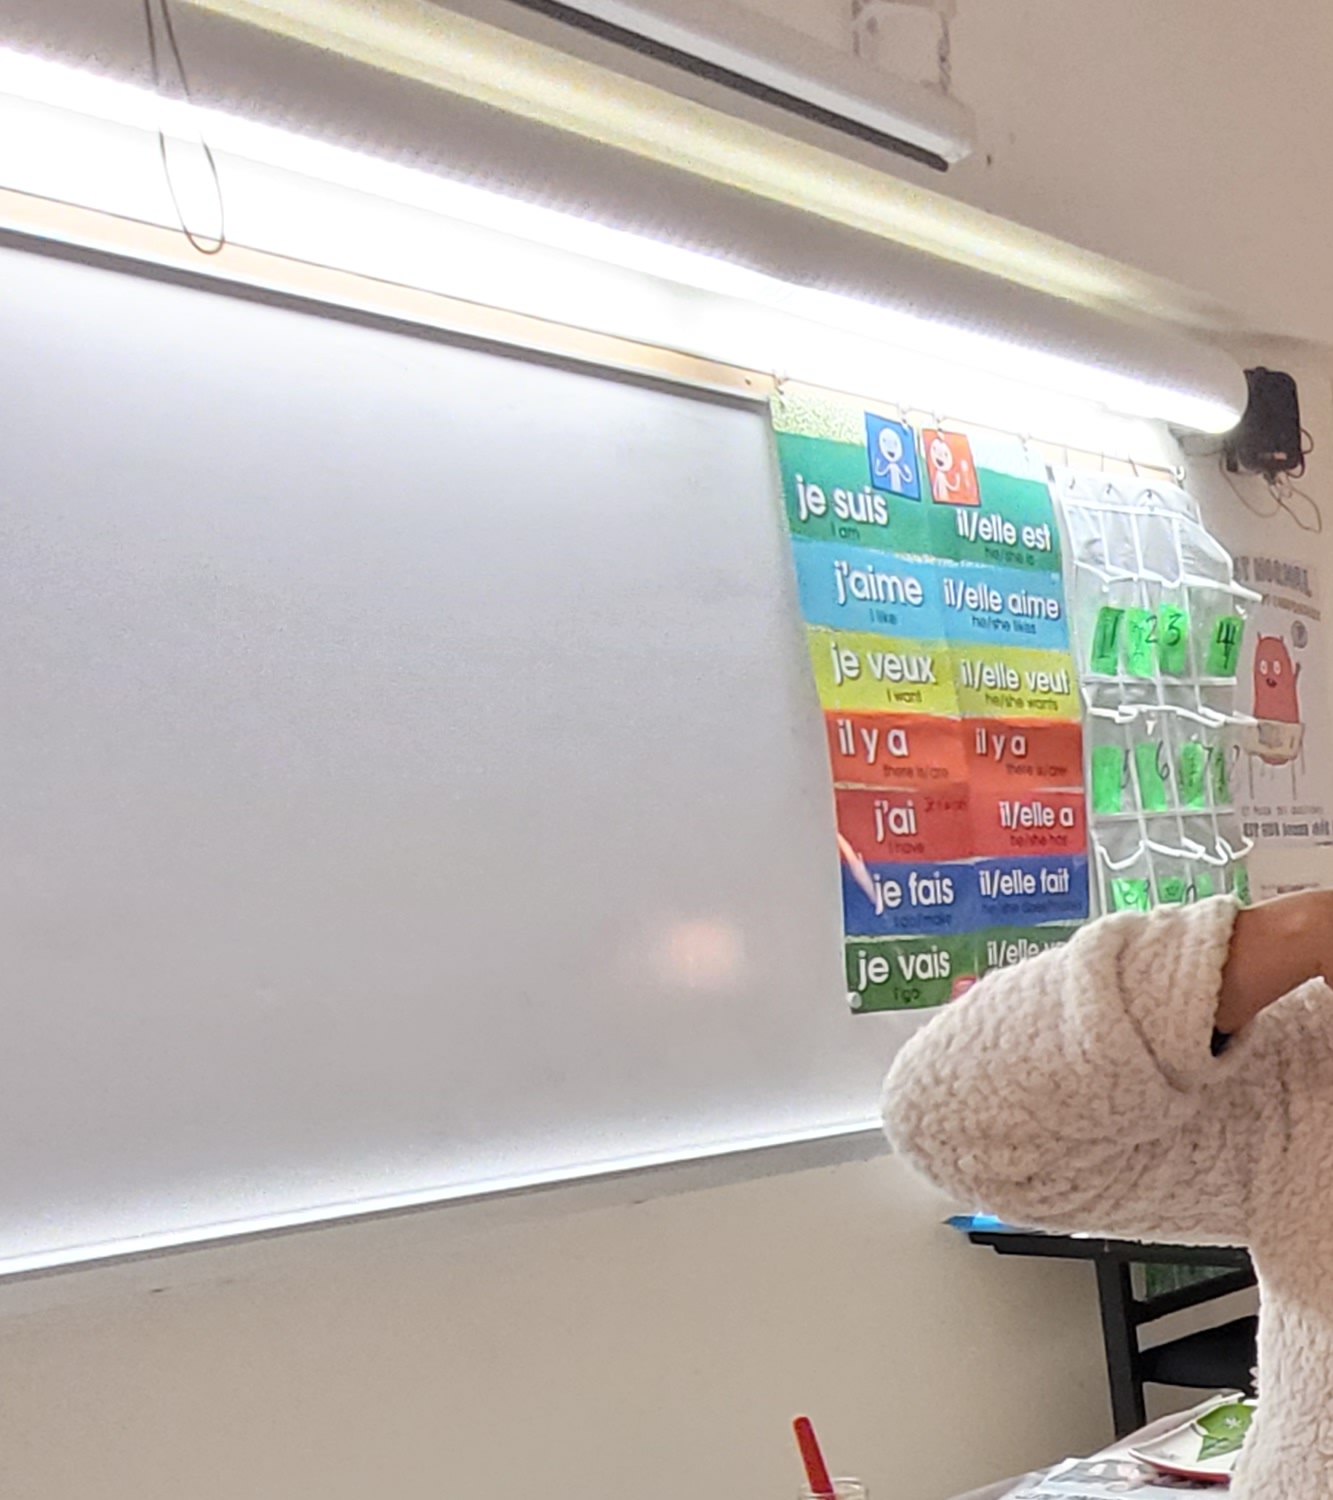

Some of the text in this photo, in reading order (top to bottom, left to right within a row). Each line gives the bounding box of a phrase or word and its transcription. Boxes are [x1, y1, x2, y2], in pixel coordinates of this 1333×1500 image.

[795, 473, 888, 526] je suis
[956, 508, 1051, 551] il/elle est
[834, 560, 925, 606] j'aime
[943, 578, 1060, 620] il/elle aime
[1166, 613, 1182, 646] 3
[831, 641, 937, 686] je veux
[961, 659, 1071, 695] il/elle veut
[837, 719, 909, 764] il y a
[975, 727, 1026, 761] il y a
[873, 799, 917, 842] j'ai
[999, 800, 1075, 830] il/elle a
[874, 871, 954, 916] je fais
[978, 868, 1070, 899] il/elle fait
[858, 945, 950, 991] je vais
